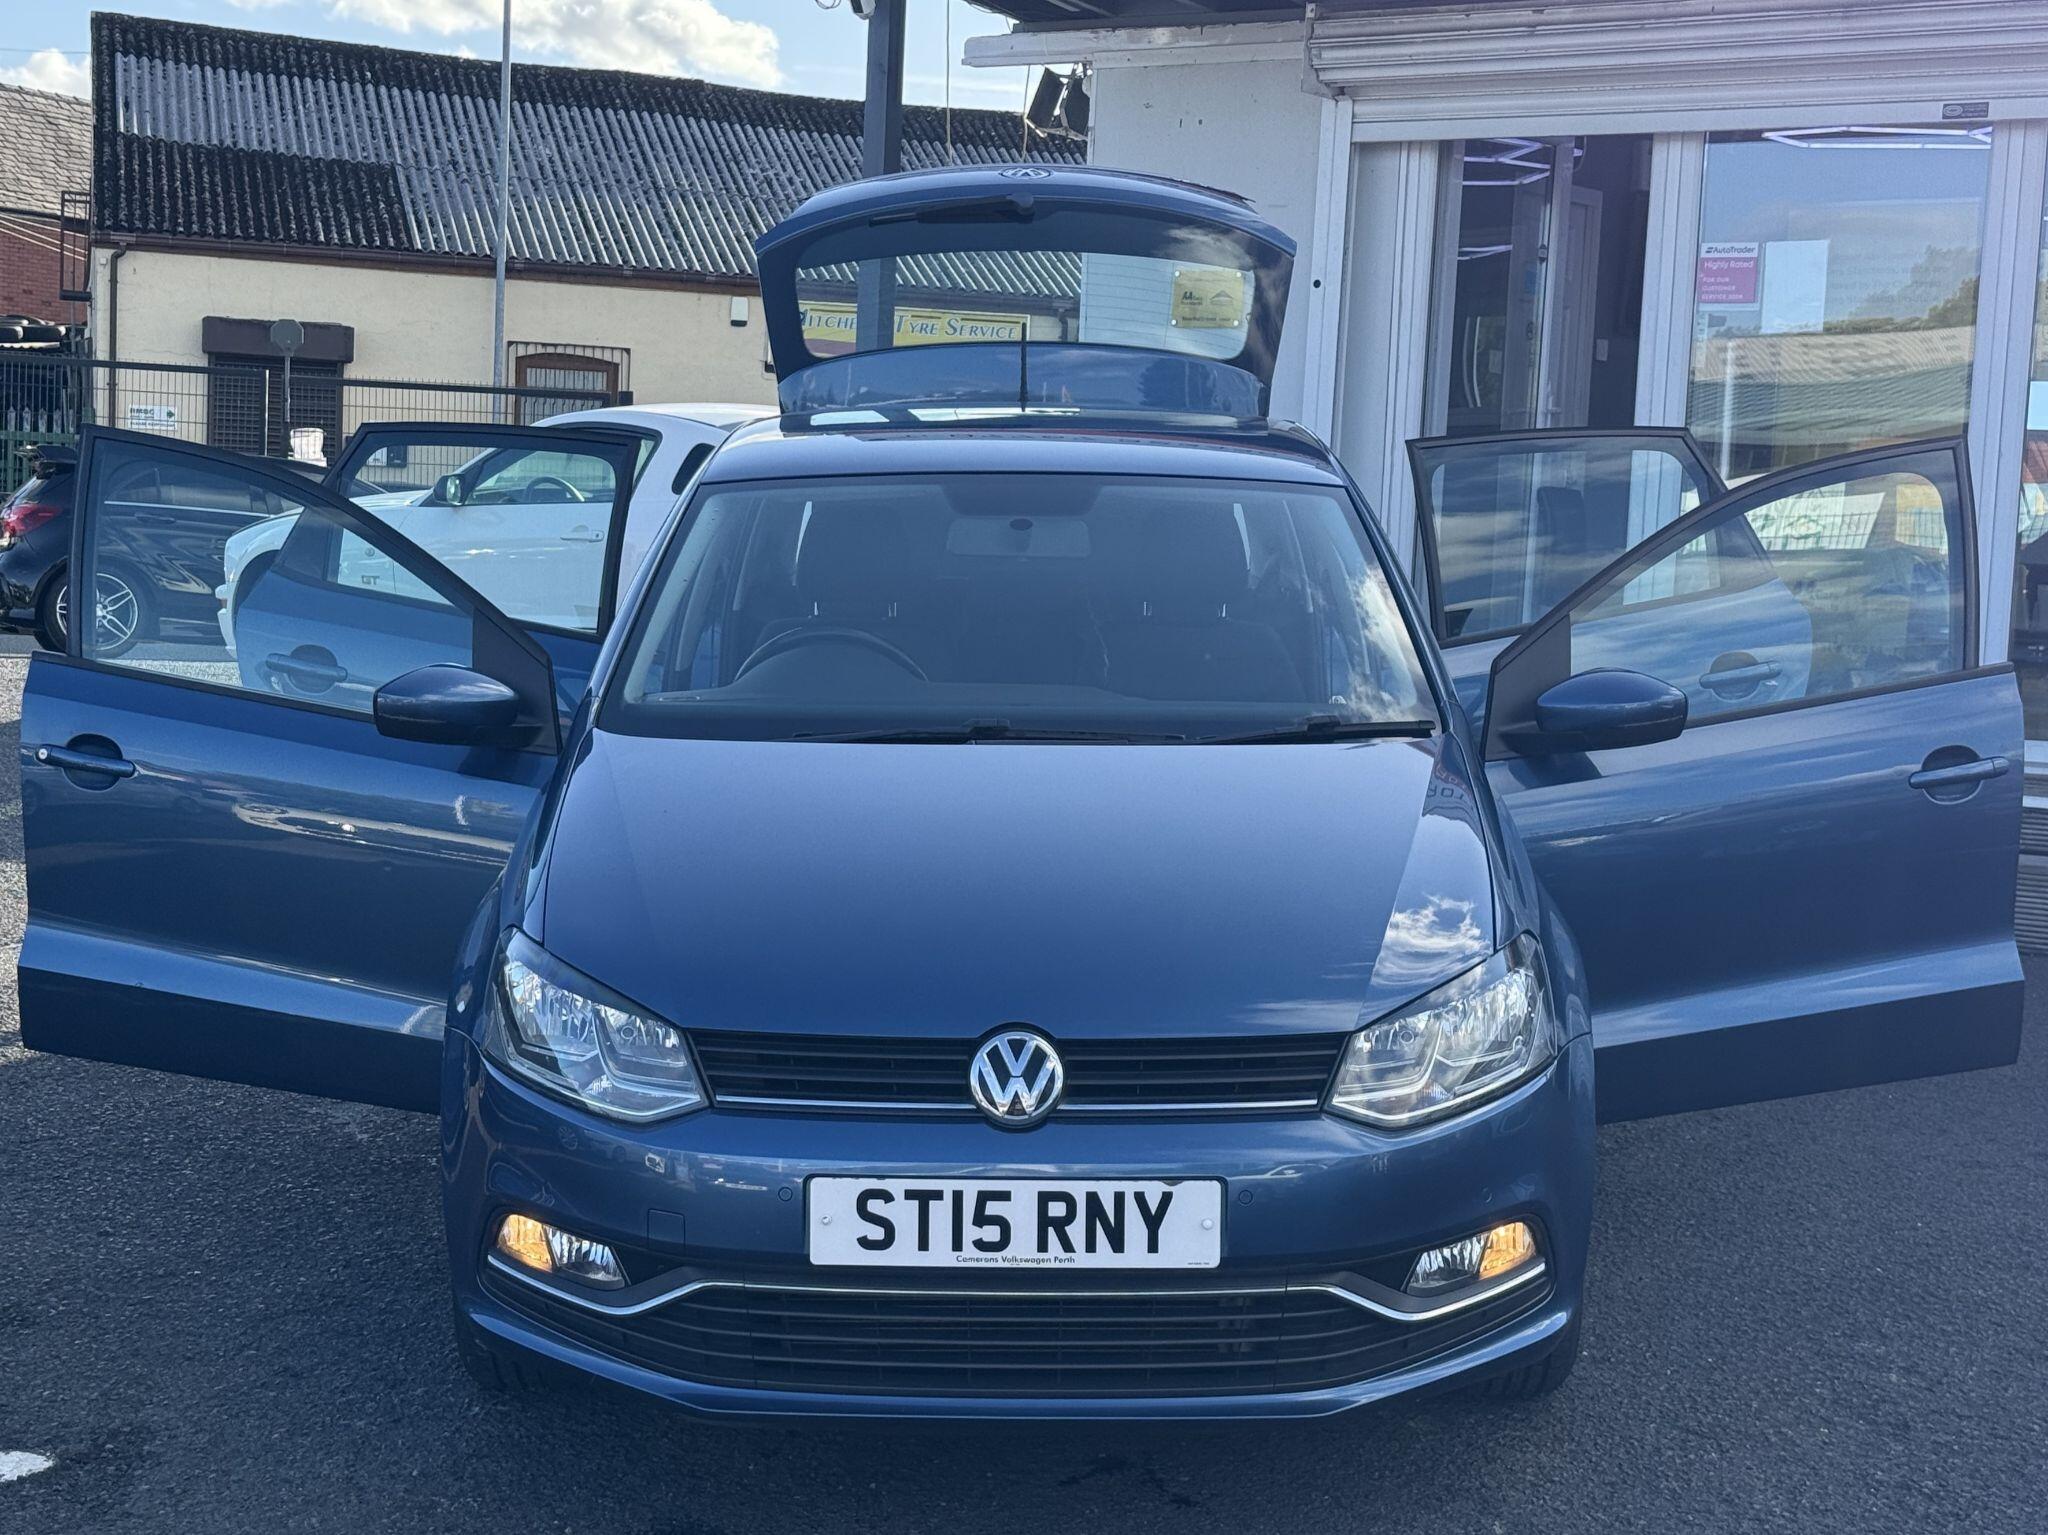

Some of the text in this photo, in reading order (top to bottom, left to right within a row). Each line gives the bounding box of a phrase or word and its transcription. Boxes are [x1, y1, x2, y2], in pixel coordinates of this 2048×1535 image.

[1712, 246, 1756, 254] AutoTrader
[1703, 260, 1754, 270] Highly Rated
[896, 315, 939, 335] TYRE
[945, 317, 1018, 339] SERVICE
[361, 575, 380, 585] GT
[856, 1188, 1174, 1254] ST15 RNY
[956, 1254, 1076, 1265] Camerons Volkswagen Perth
